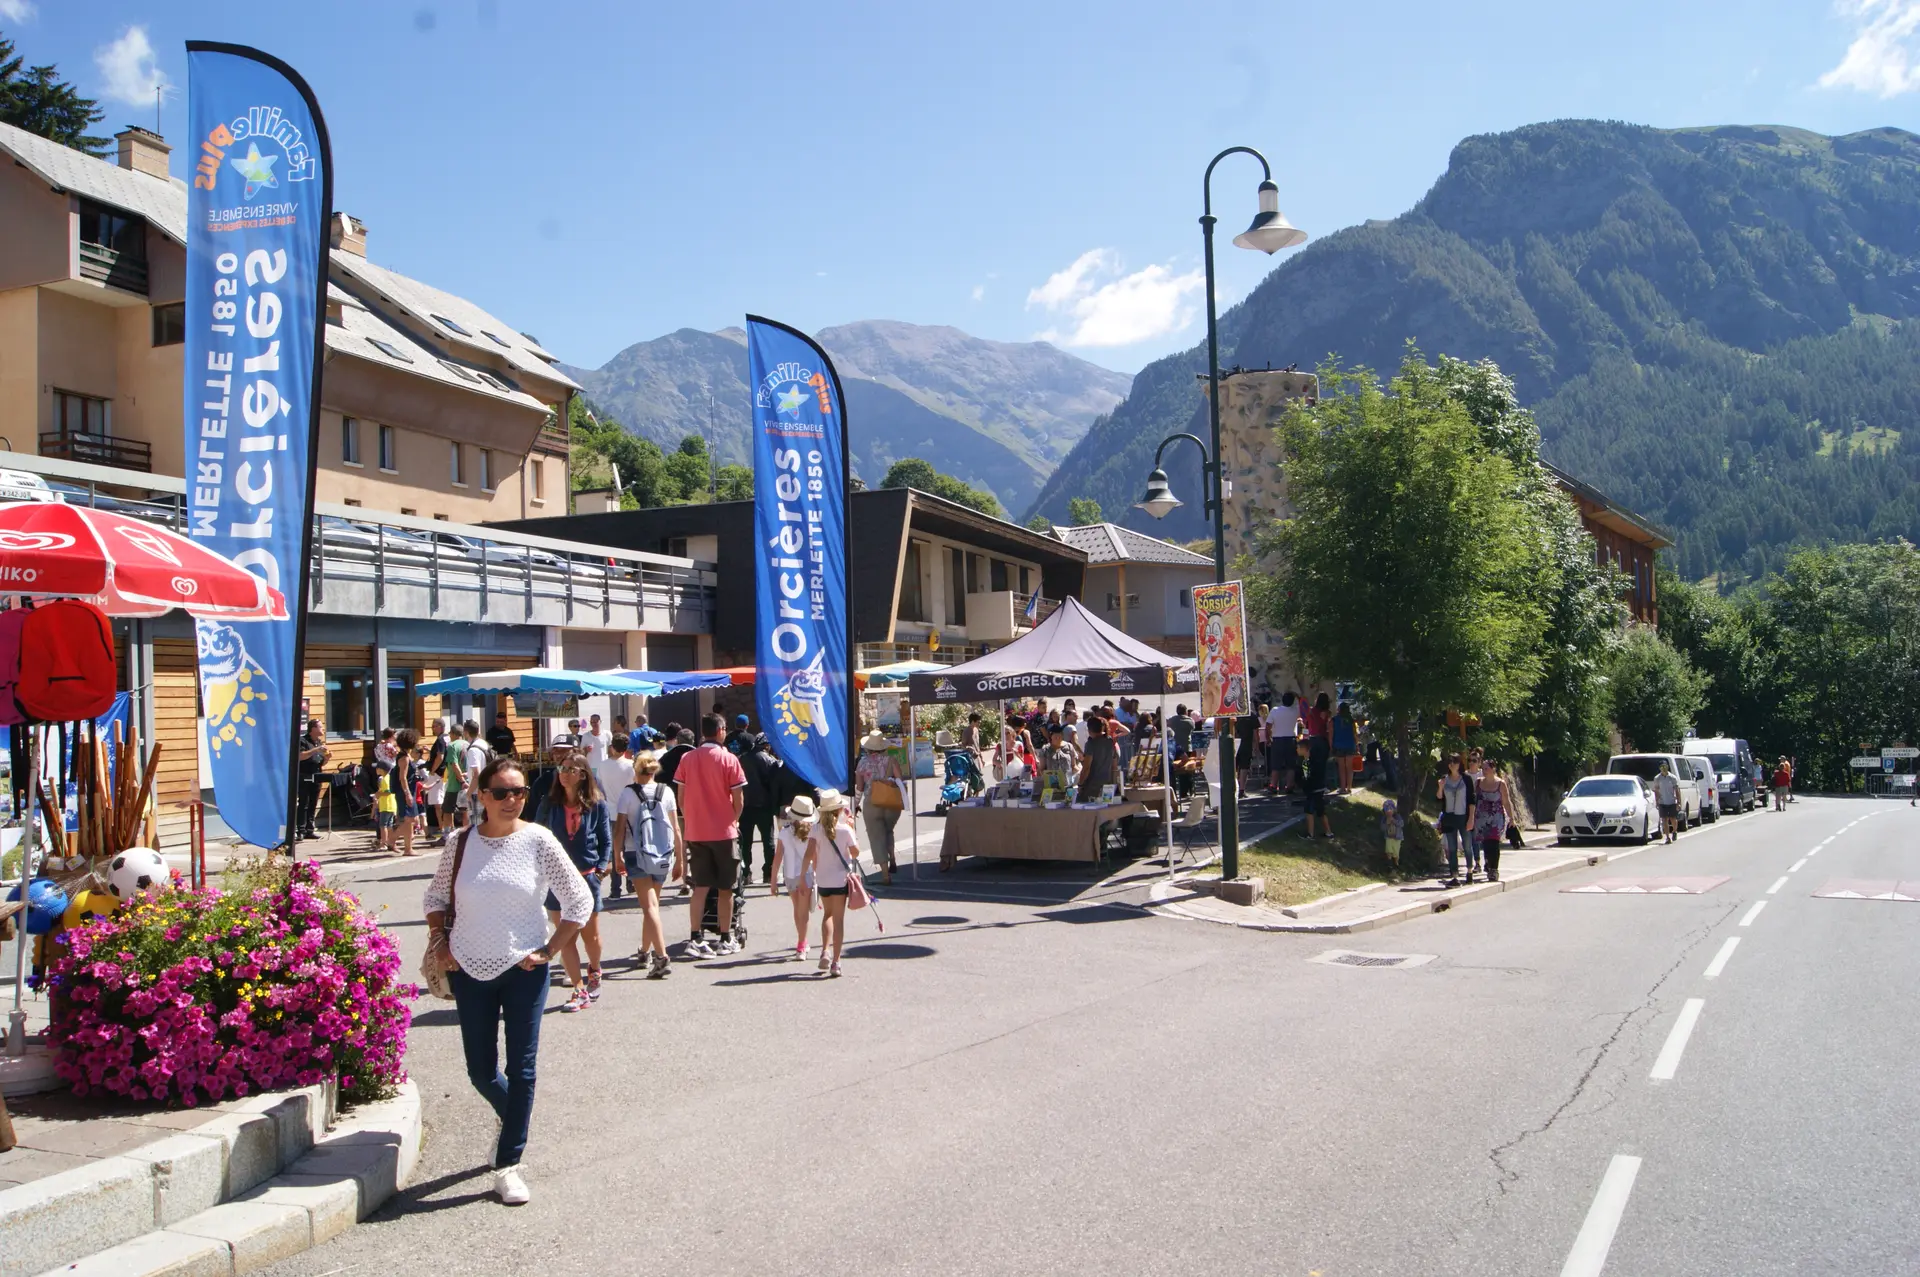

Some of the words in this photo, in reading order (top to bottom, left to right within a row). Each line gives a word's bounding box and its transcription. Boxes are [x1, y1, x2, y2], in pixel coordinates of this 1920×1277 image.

[757, 362, 812, 409] Famille
[784, 422, 824, 433] ENSEMBLE
[807, 450, 823, 501] 1850
[769, 447, 808, 662] Orcières
[807, 510, 825, 621] MERLETTE
[0, 566, 37, 582] IKO
[1197, 596, 1238, 610] CORSICA
[977, 675, 1086, 692] ORCIERES.COM
